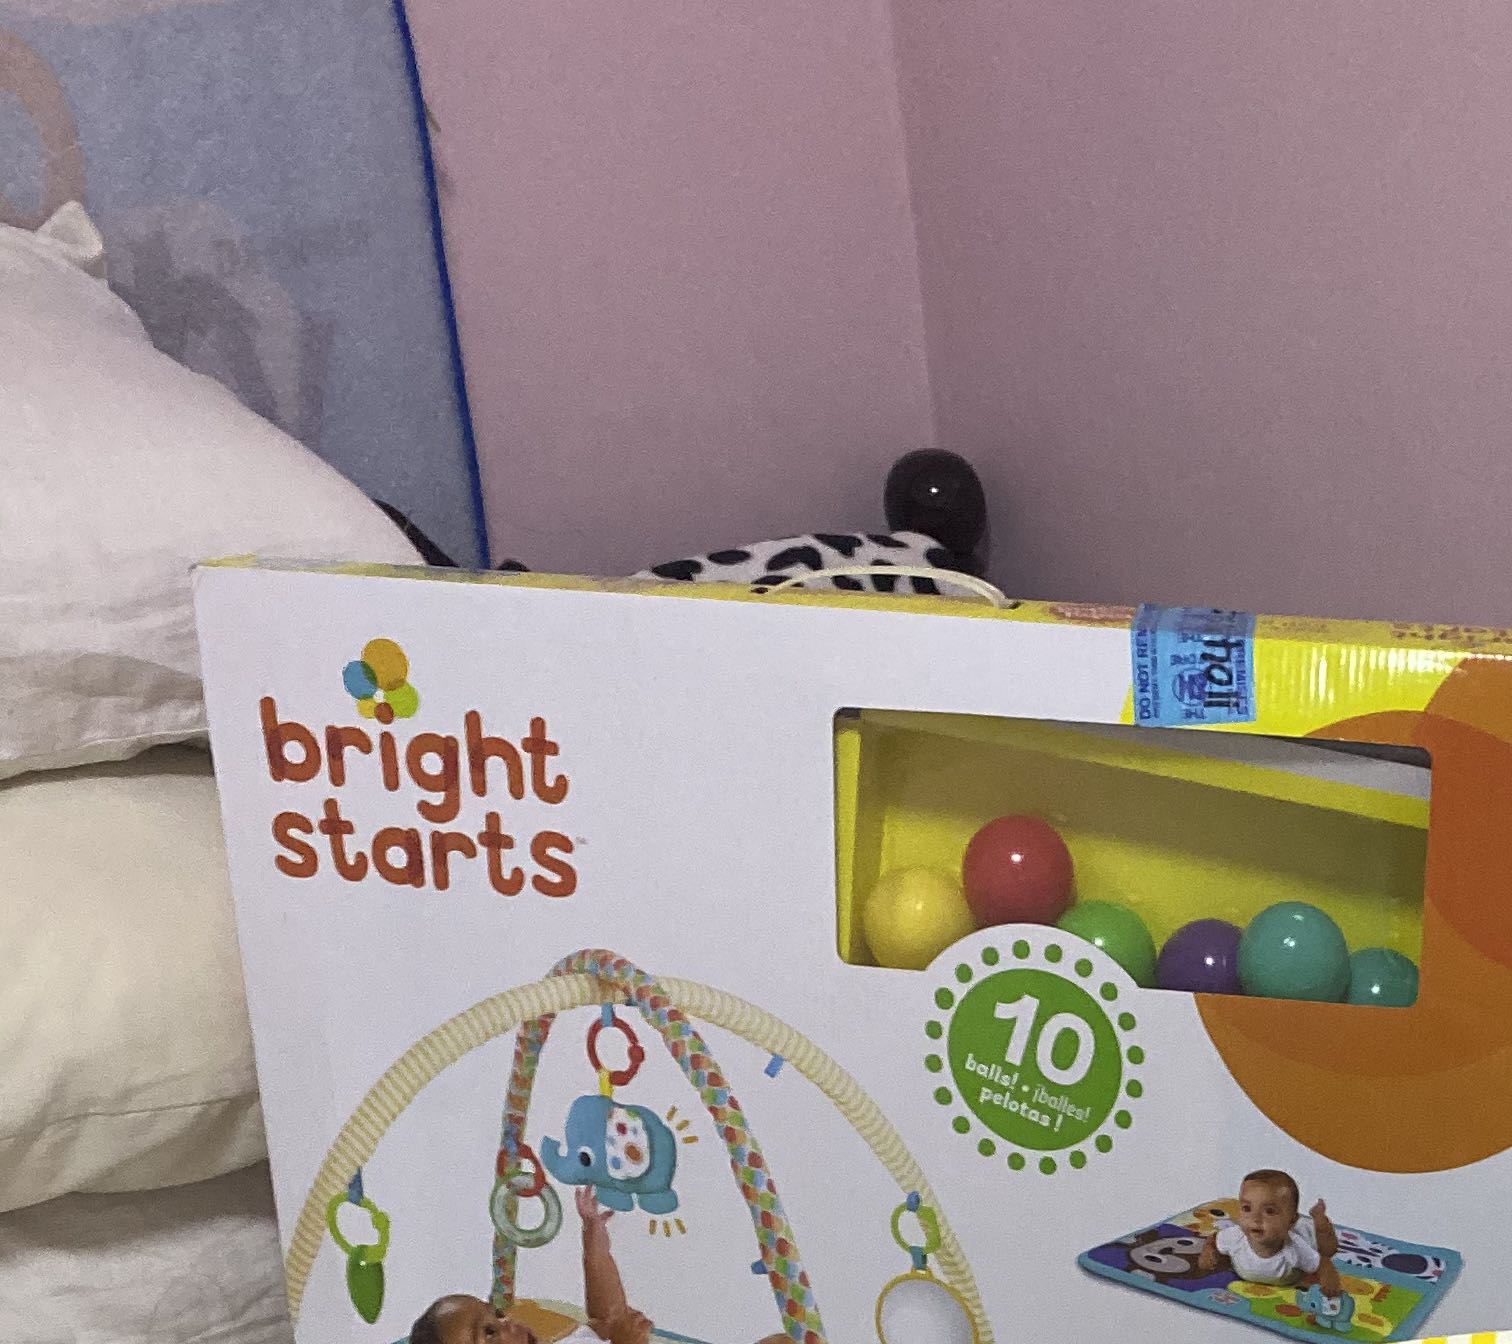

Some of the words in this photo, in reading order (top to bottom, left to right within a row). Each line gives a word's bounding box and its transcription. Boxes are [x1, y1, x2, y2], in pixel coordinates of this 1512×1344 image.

[1137, 664, 1149, 693] NOT
[259, 696, 569, 824] bright
[271, 797, 578, 898] starts
[965, 1053, 1020, 1089] balls!
[993, 994, 1096, 1086] 10
